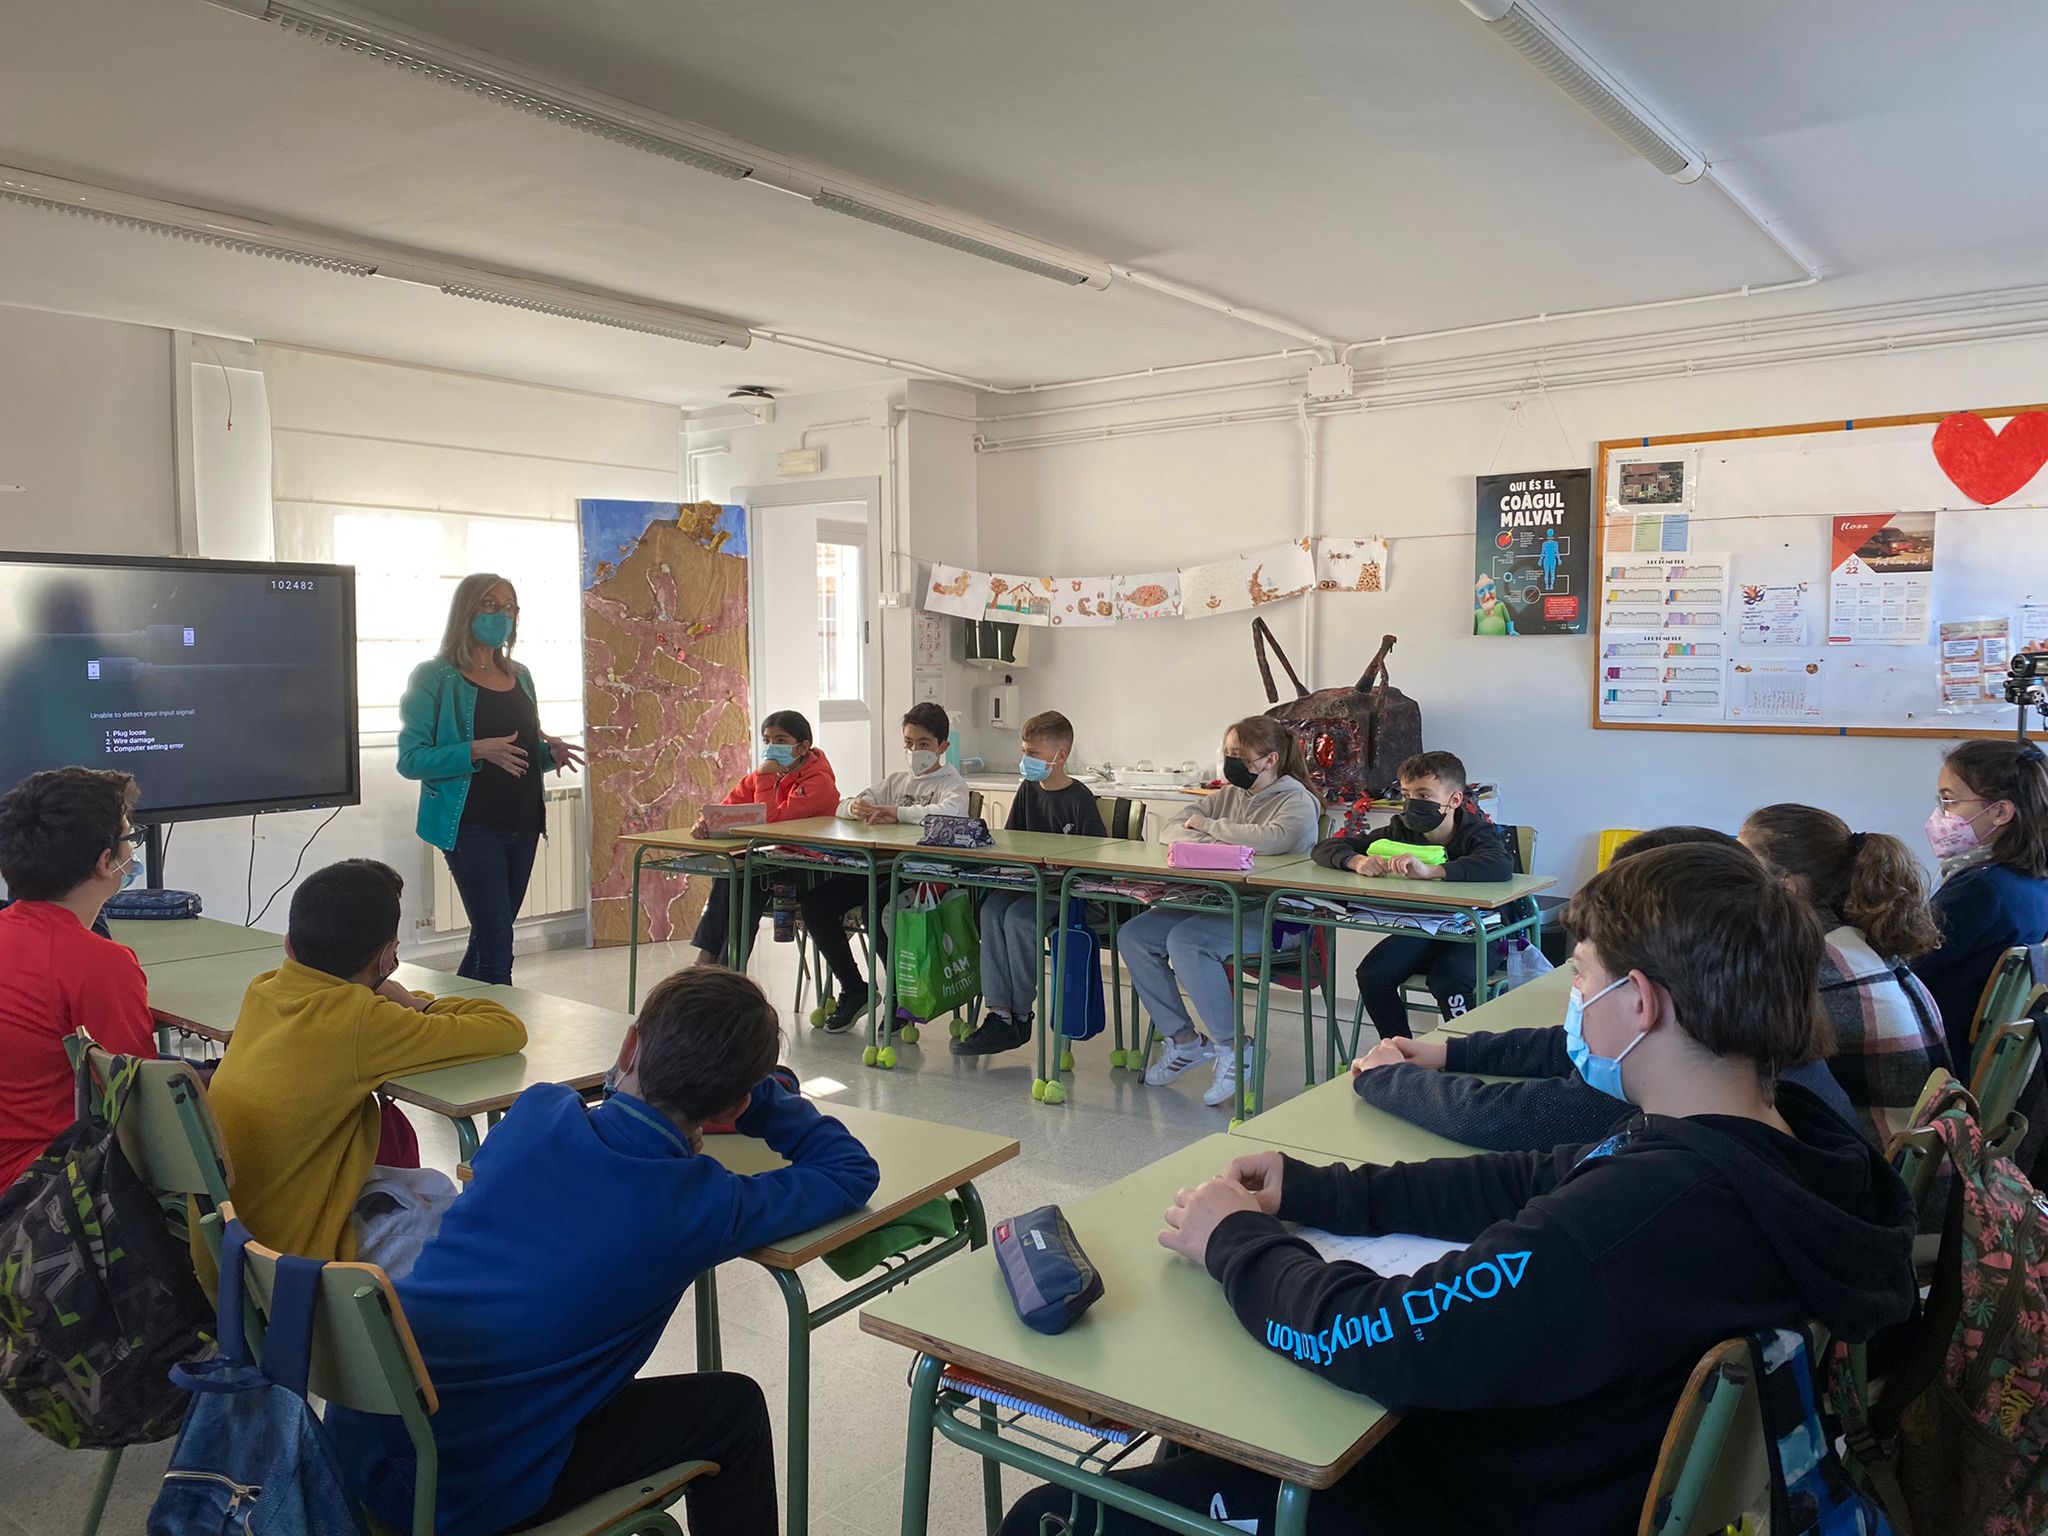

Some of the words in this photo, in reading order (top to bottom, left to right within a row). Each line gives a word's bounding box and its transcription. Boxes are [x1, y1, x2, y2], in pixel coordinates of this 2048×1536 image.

[1509, 481, 1526, 492] QUI
[1529, 478, 1541, 490] ÉS
[1544, 479, 1556, 490] EL
[1500, 491, 1565, 511] COÀGUL
[1500, 509, 1565, 528] MALVAT
[1847, 558, 1859, 566] 20
[1845, 567, 1858, 575] 22
[271, 580, 314, 590] 102482
[143, 711, 158, 719] your
[113, 729, 128, 738] Plug
[129, 736, 155, 744] damage
[113, 745, 145, 753] Computer
[146, 743, 168, 751] setting
[169, 742, 185, 750] error
